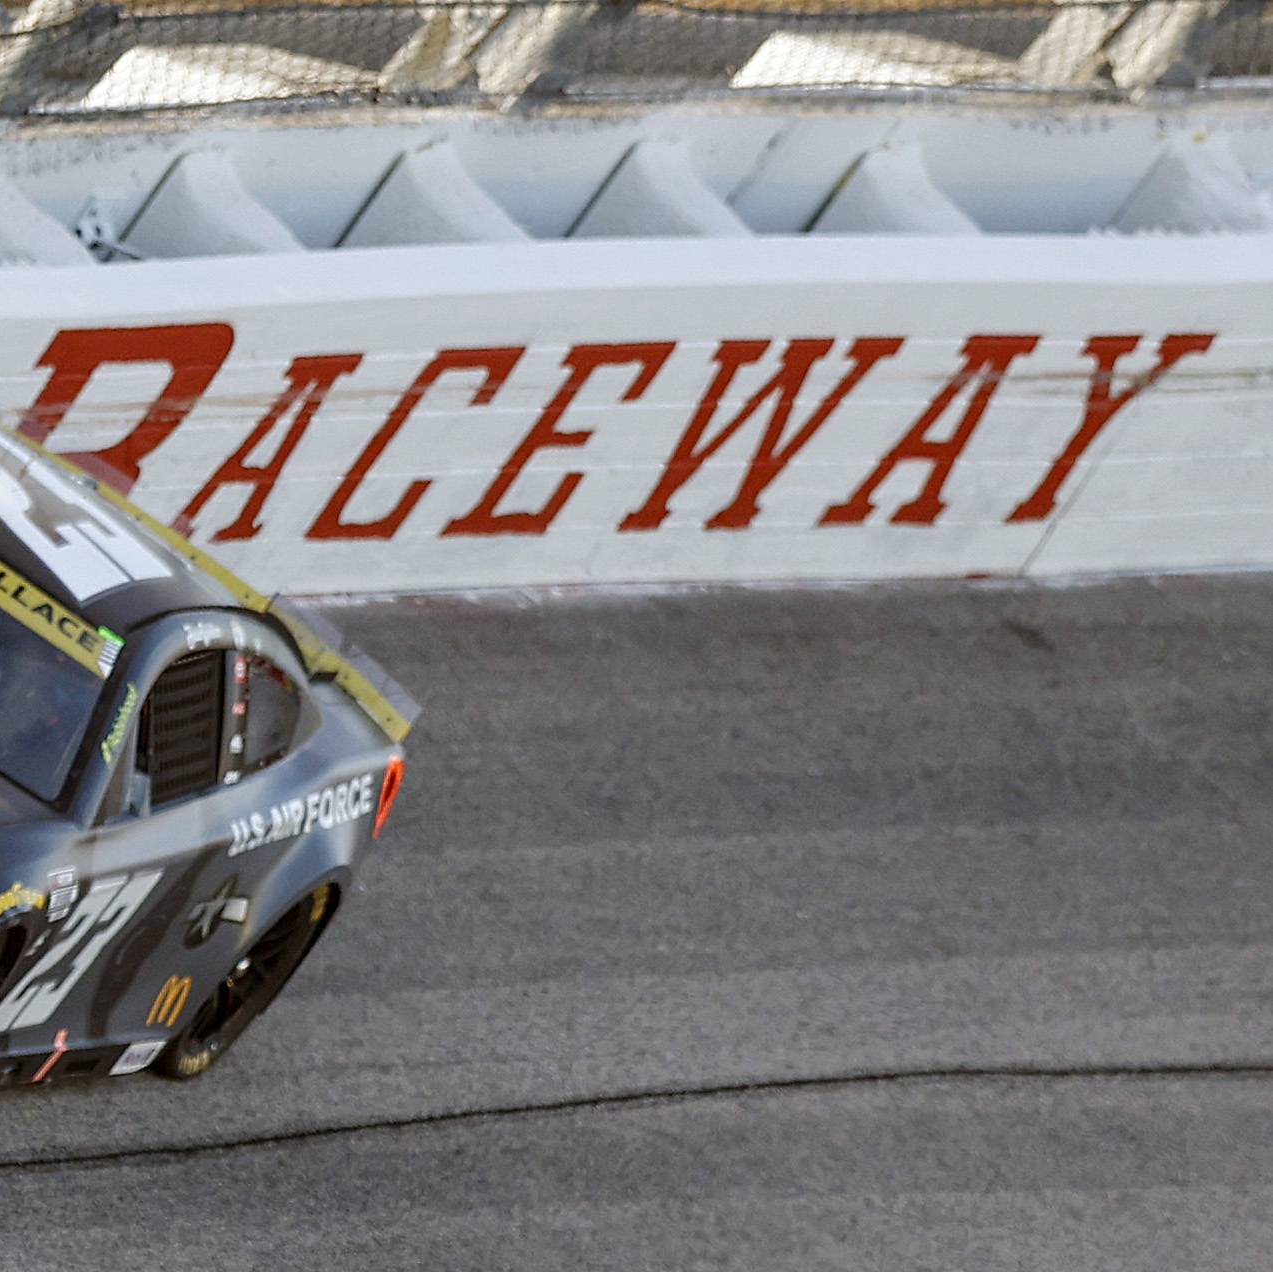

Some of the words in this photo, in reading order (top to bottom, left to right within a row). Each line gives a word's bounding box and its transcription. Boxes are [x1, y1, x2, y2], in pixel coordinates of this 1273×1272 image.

[17, 322, 1219, 543] RACEWAY
[264, 798, 305, 844] AIR
[302, 772, 375, 834] FORCE
